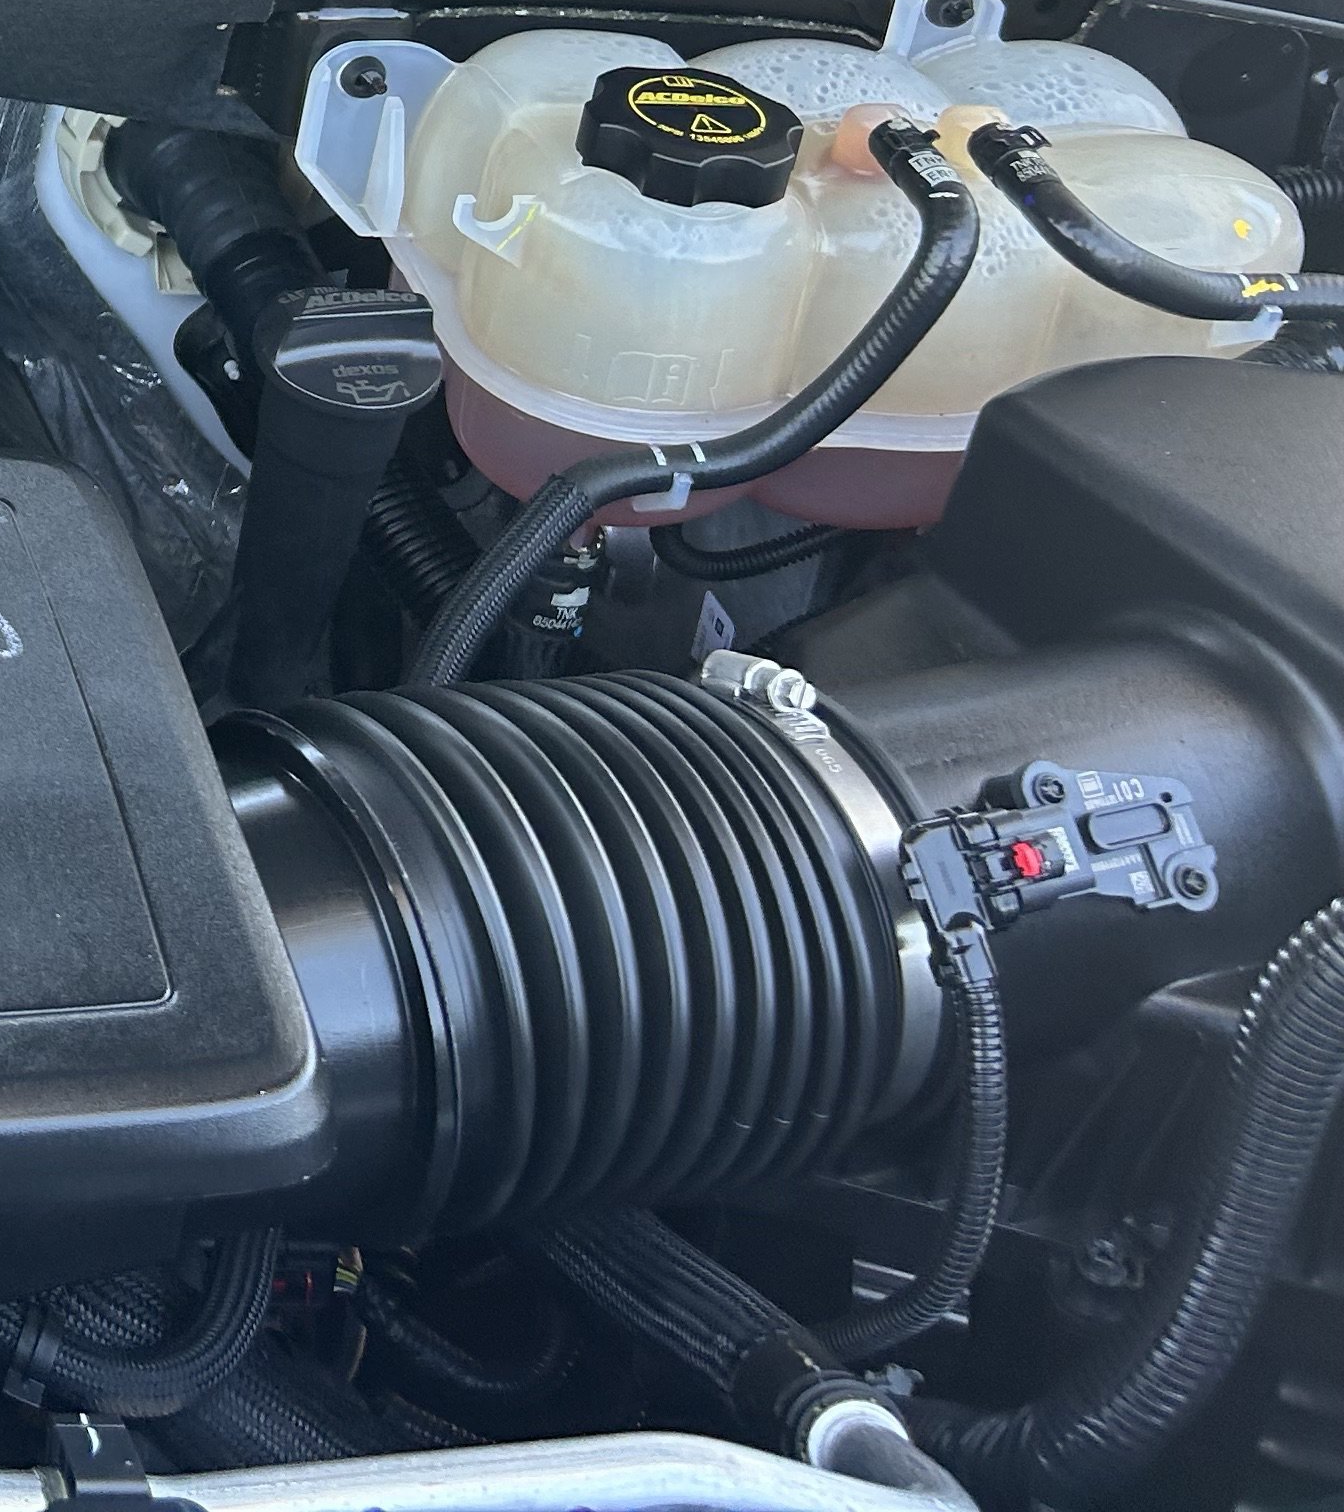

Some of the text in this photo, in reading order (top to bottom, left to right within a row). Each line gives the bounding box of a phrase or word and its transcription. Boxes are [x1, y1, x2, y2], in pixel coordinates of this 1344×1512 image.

[633, 91, 747, 106] ACDelco
[305, 288, 418, 308] ACDelco
[332, 364, 399, 377] dexos
[556, 606, 579, 620] TNK
